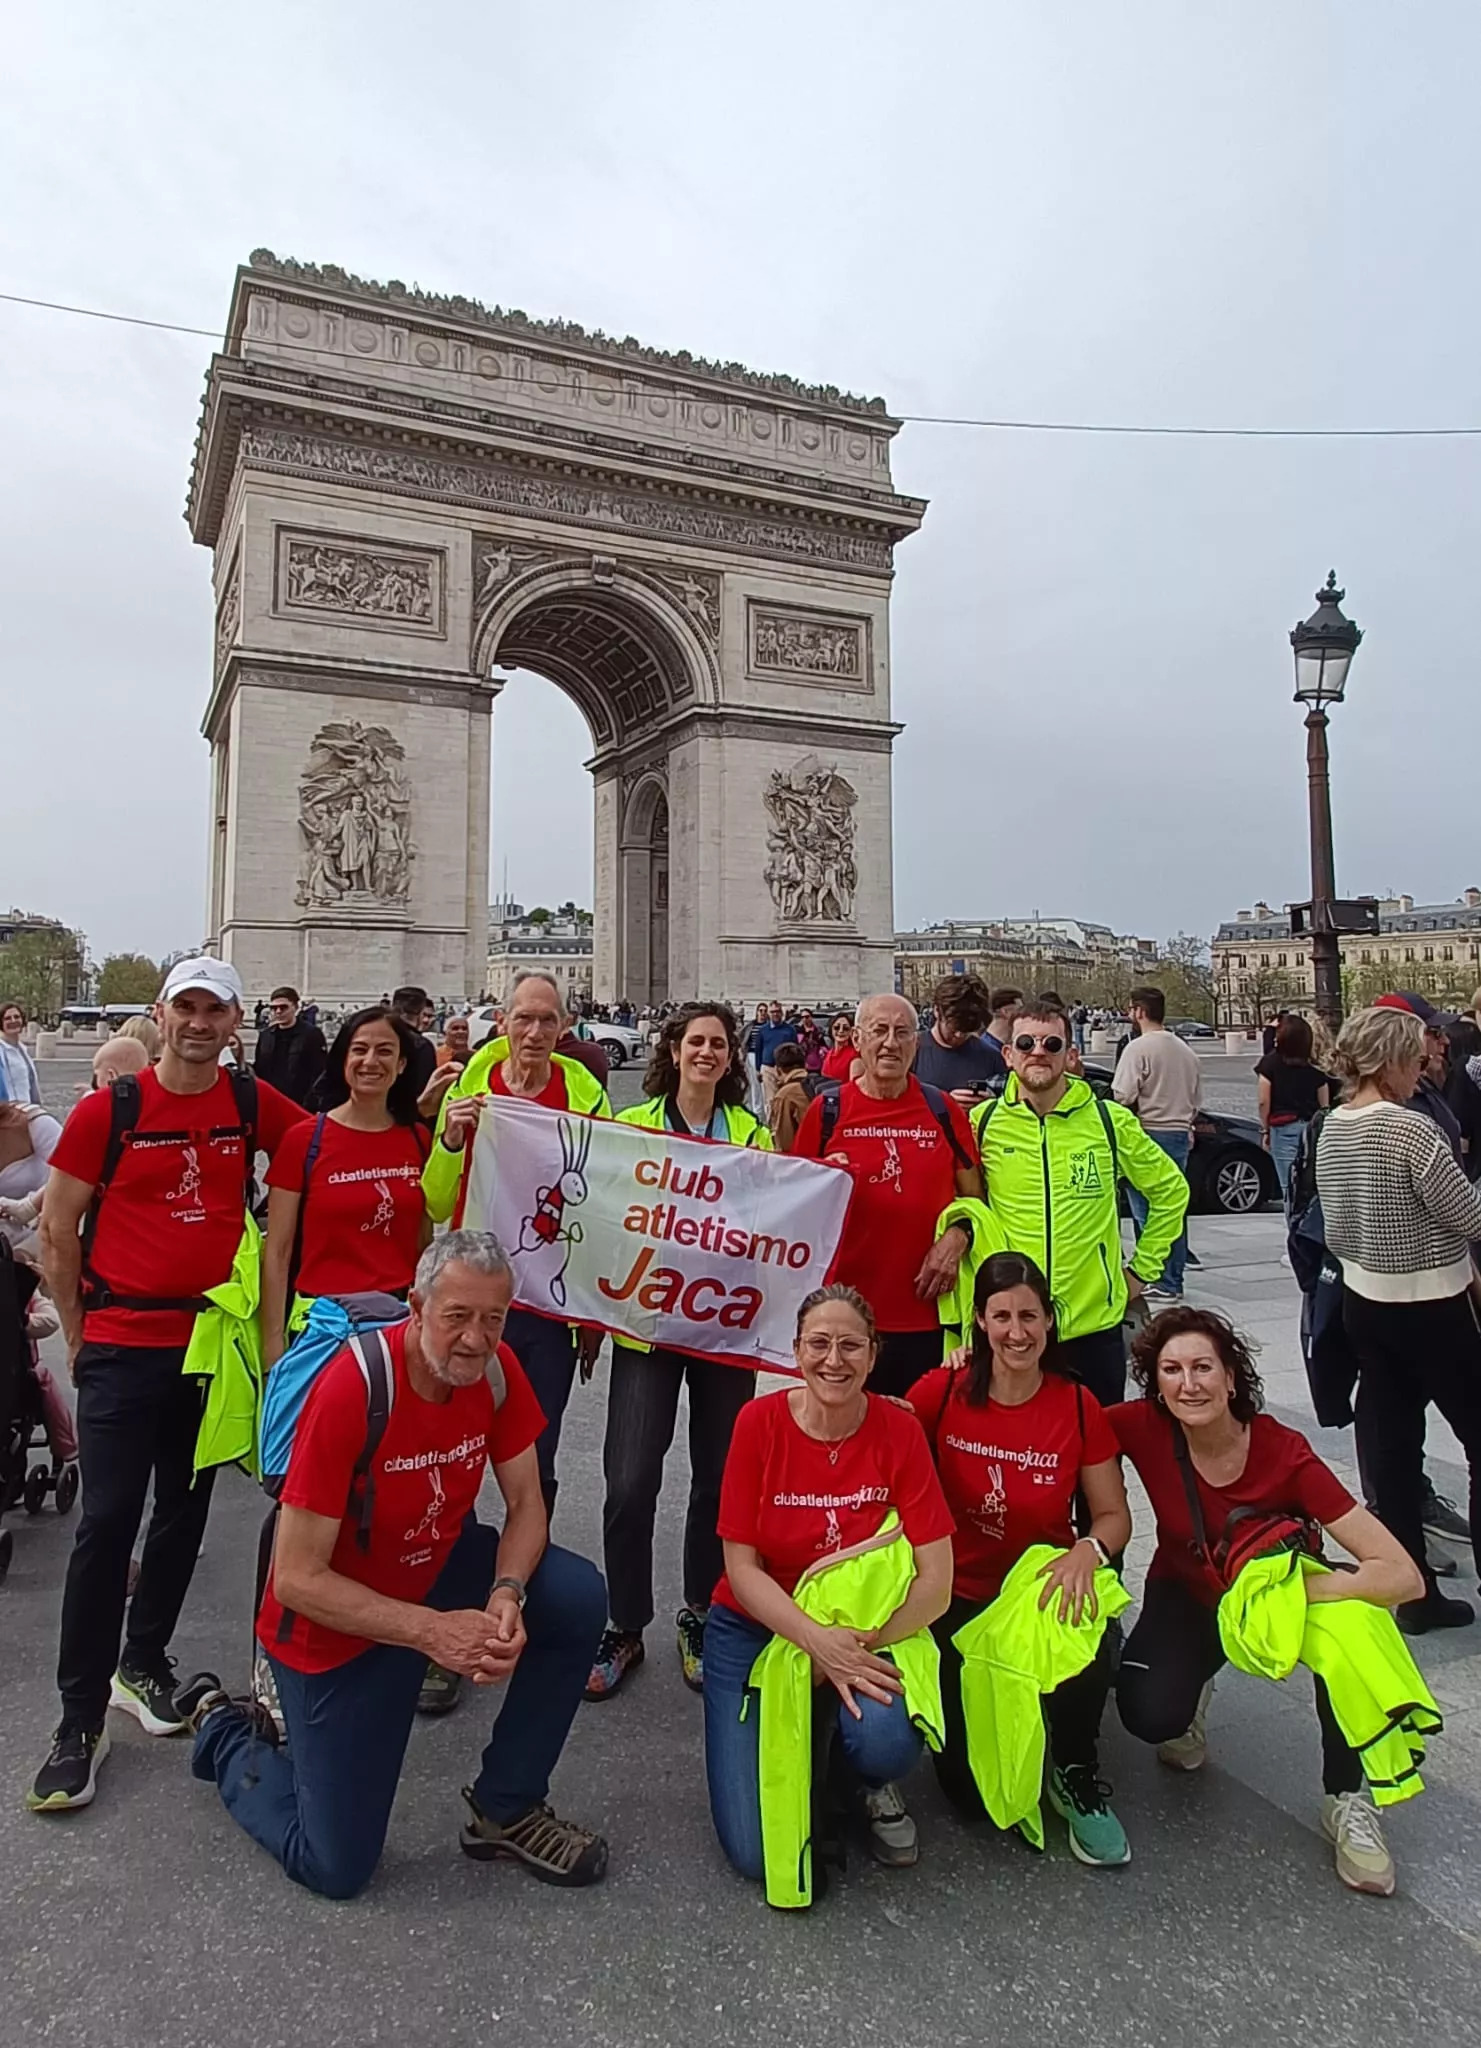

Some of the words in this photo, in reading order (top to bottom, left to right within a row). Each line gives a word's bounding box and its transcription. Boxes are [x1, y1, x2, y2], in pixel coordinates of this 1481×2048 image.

[634, 1157, 724, 1203] club
[623, 1203, 811, 1269] atletismo
[598, 1247, 763, 1330] Jaca
